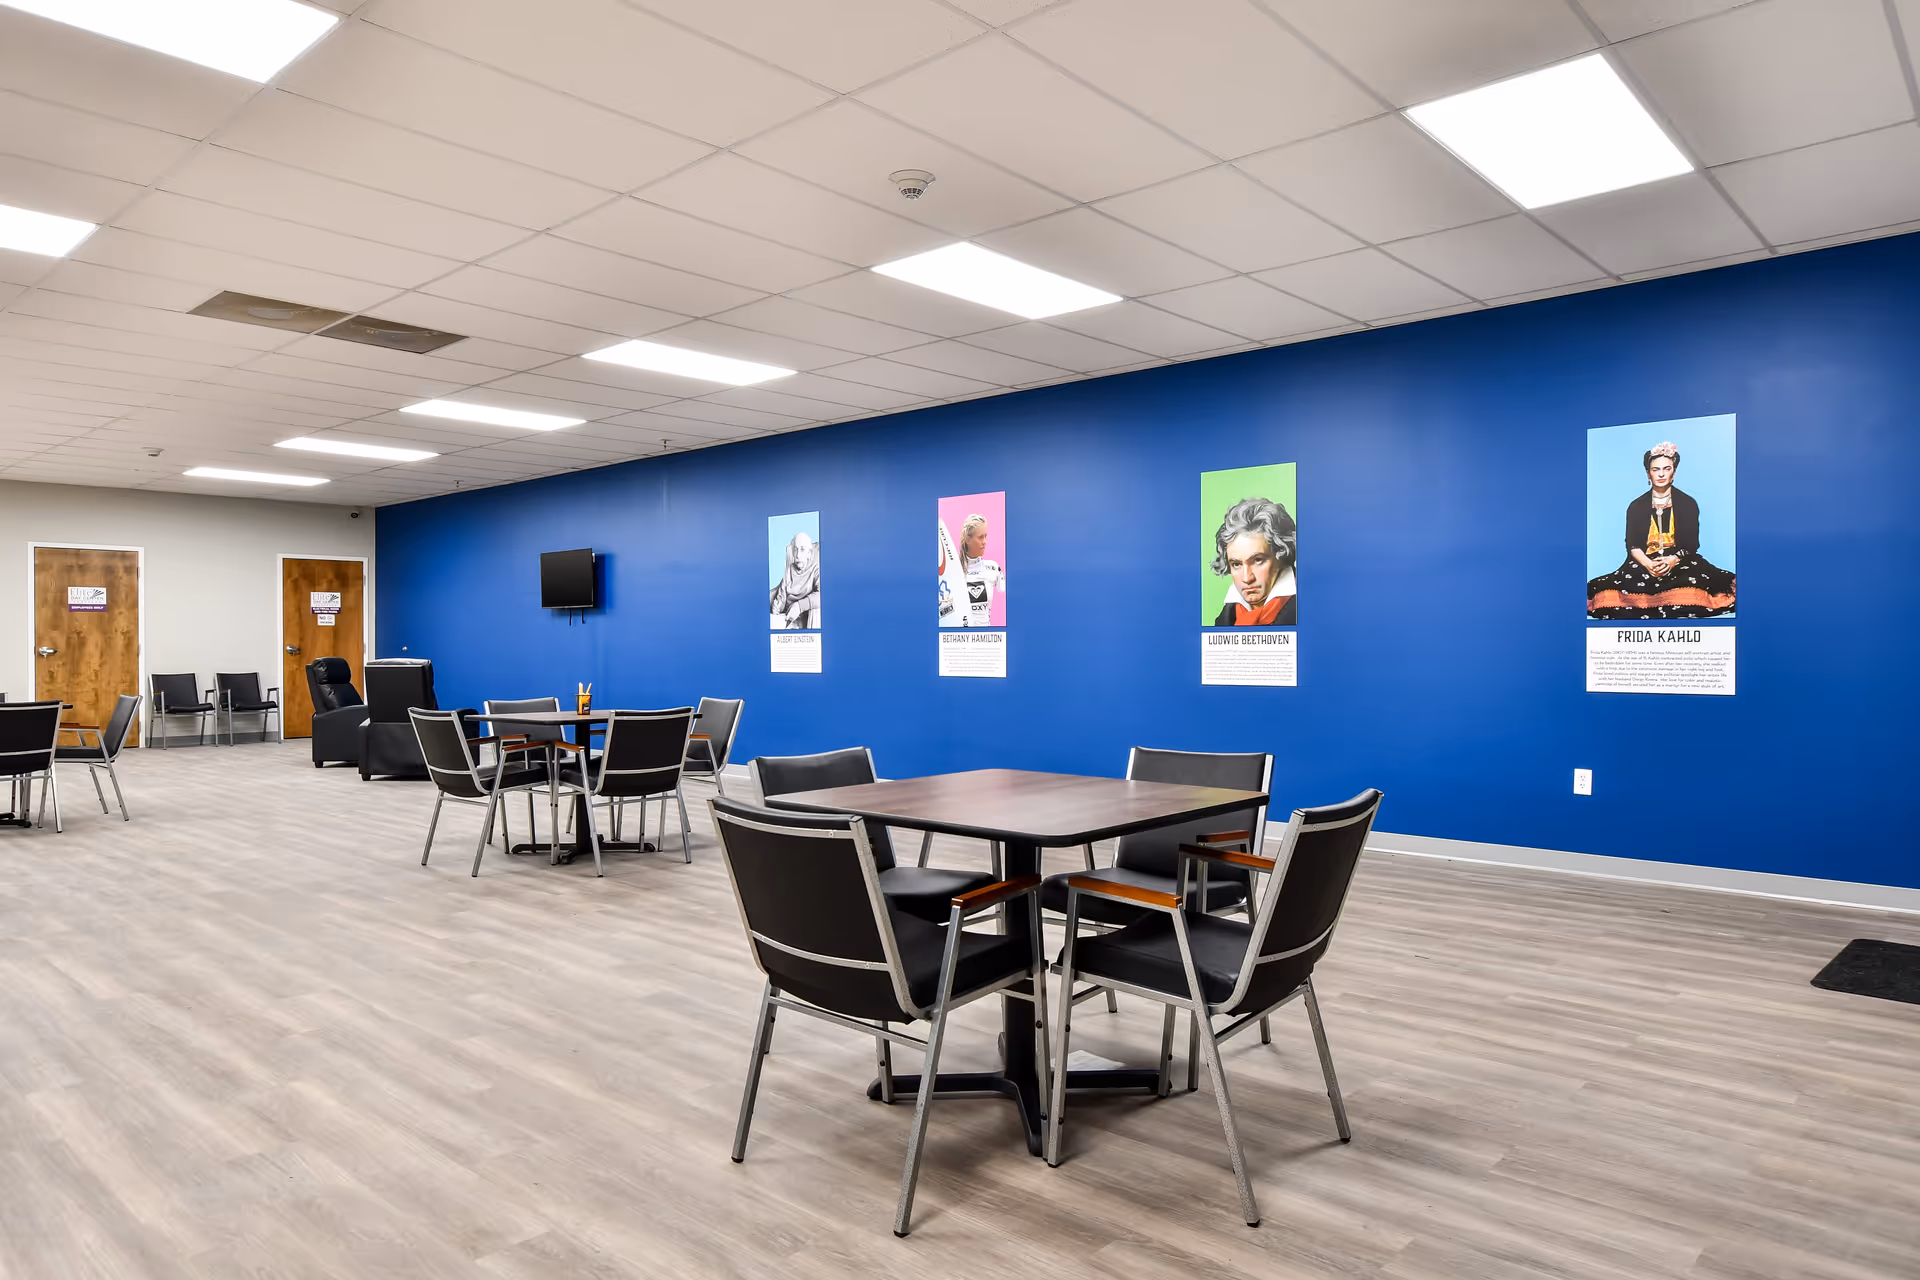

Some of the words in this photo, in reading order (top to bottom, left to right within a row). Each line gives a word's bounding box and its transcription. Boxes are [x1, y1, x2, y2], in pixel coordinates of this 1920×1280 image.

[942, 634, 970, 643] BETHANY
[972, 634, 1002, 643] HAMILTON
[1208, 634, 1239, 645] LUDWIG
[1242, 634, 1290, 645] BEETHOVEN
[1617, 630, 1653, 643] FRIDA
[1658, 630, 1701, 643] KAHLO
